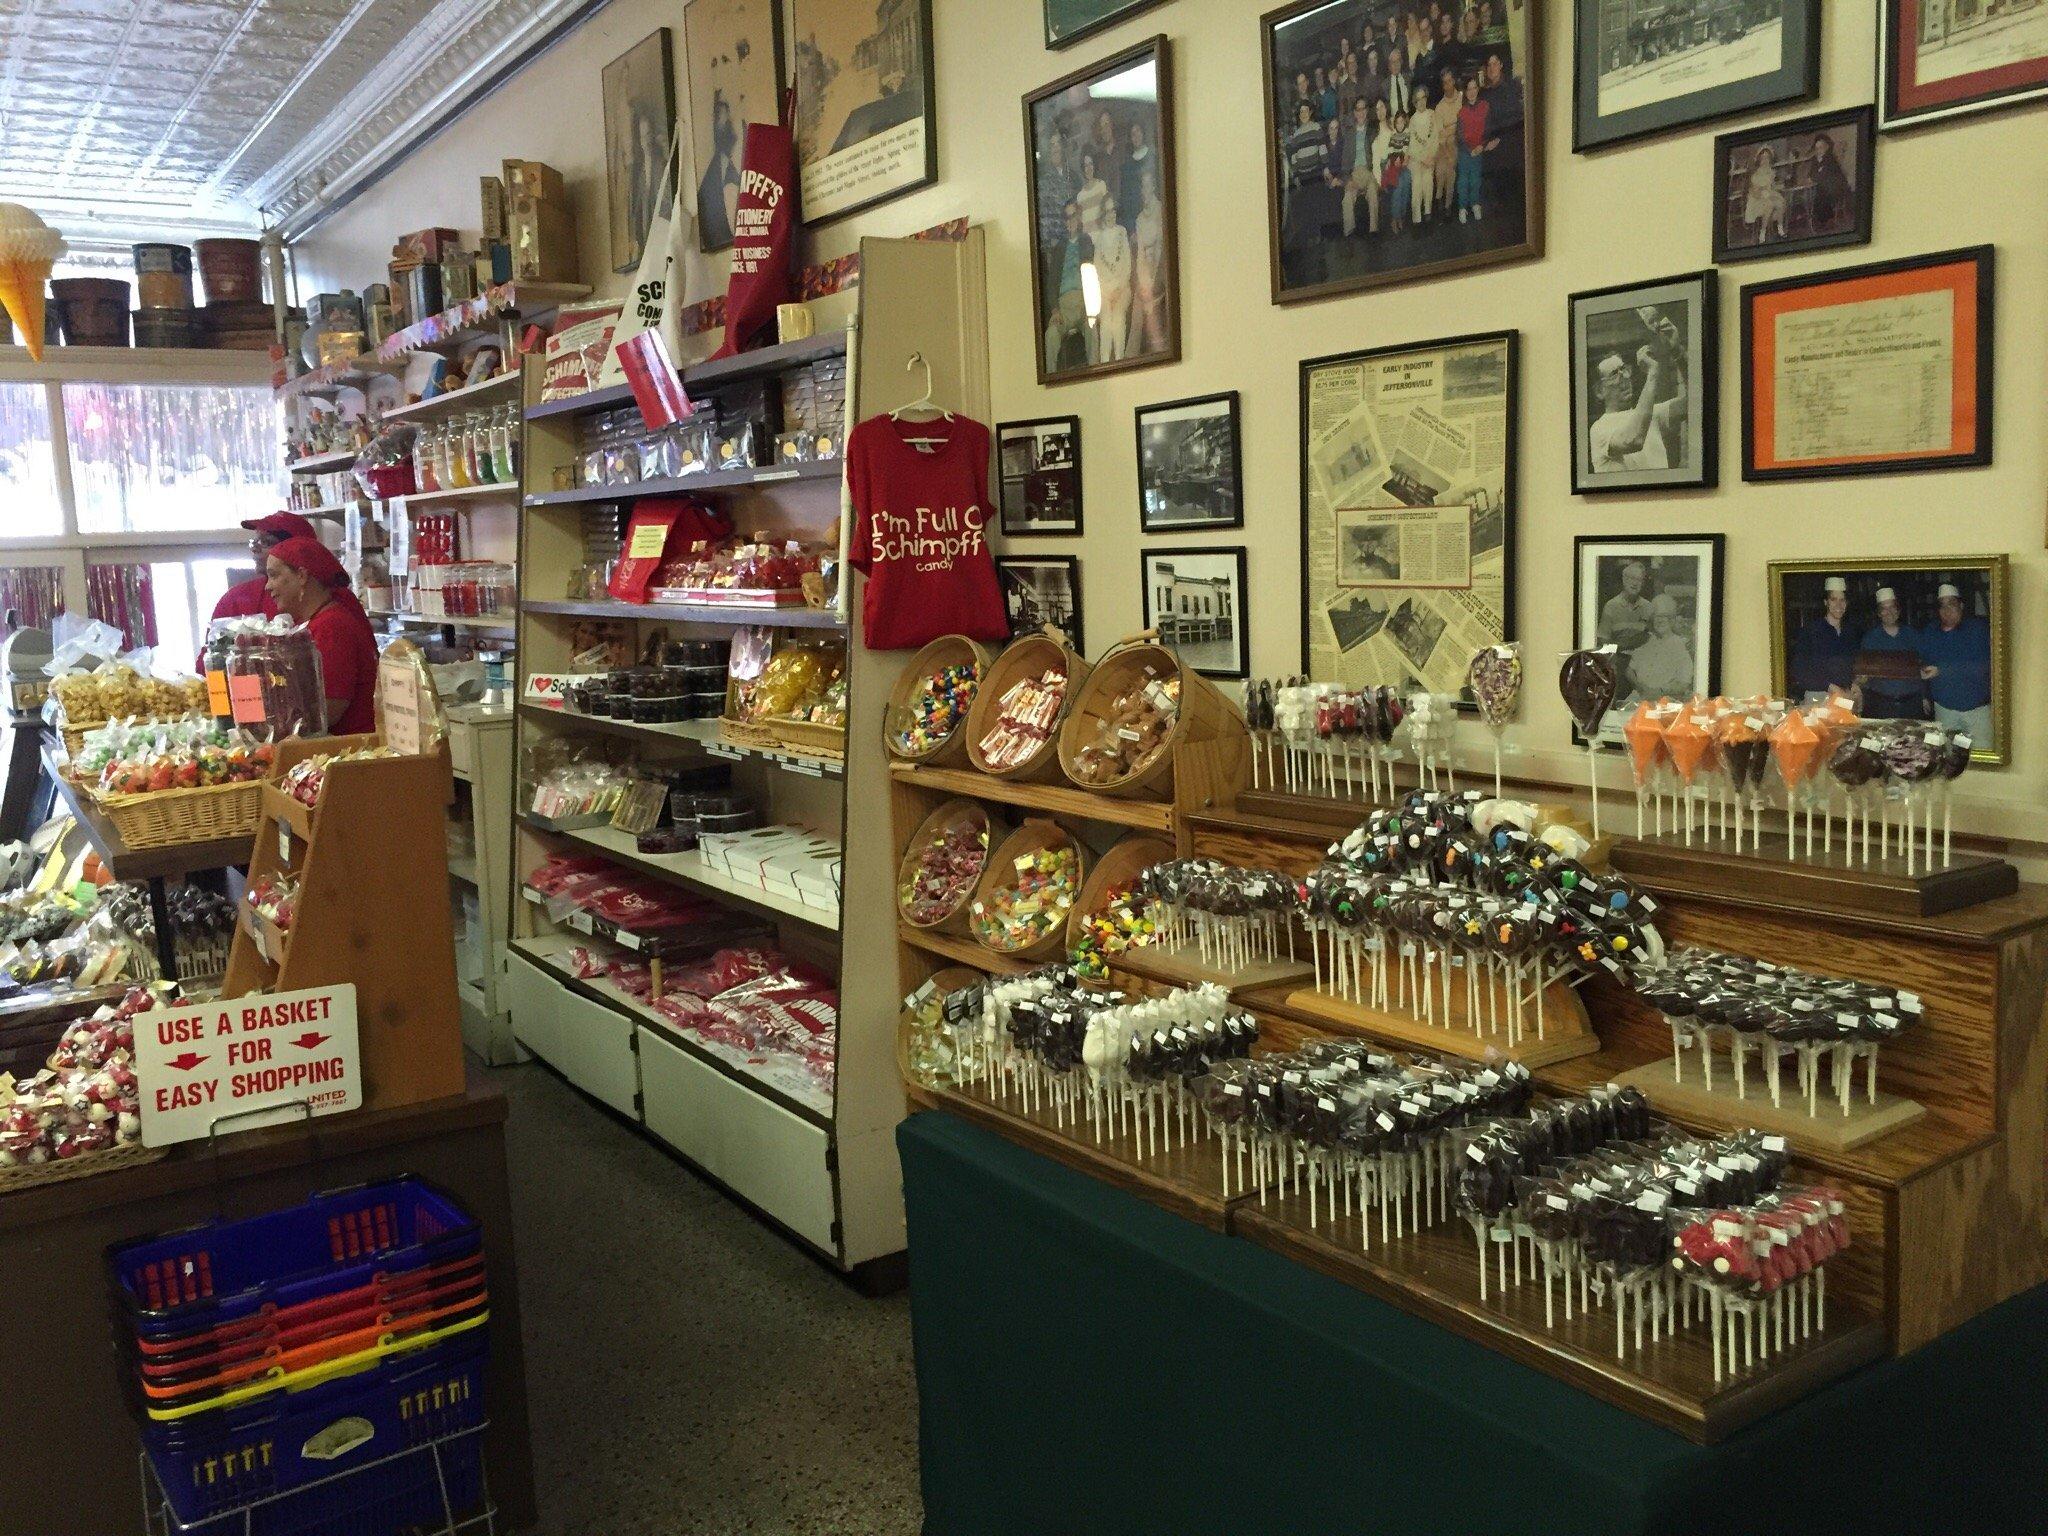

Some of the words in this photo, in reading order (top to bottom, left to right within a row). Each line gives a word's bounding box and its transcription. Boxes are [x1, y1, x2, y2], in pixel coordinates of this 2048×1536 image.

[1382, 363, 1402, 375] EARLY
[1403, 360, 1434, 372] INDUSTRY
[1382, 379, 1434, 392] JEFFERSONVILLE
[871, 510, 910, 538] I'm
[915, 506, 958, 534] Full
[916, 558, 955, 573] candy
[157, 1016, 204, 1046] USE
[216, 1012, 233, 1036] A
[242, 996, 332, 1033] BASKET
[227, 1037, 273, 1067] FOR
[156, 1079, 219, 1113] EASY
[231, 1056, 345, 1099] SHOPPING
[306, 1089, 347, 1105] UNITED
